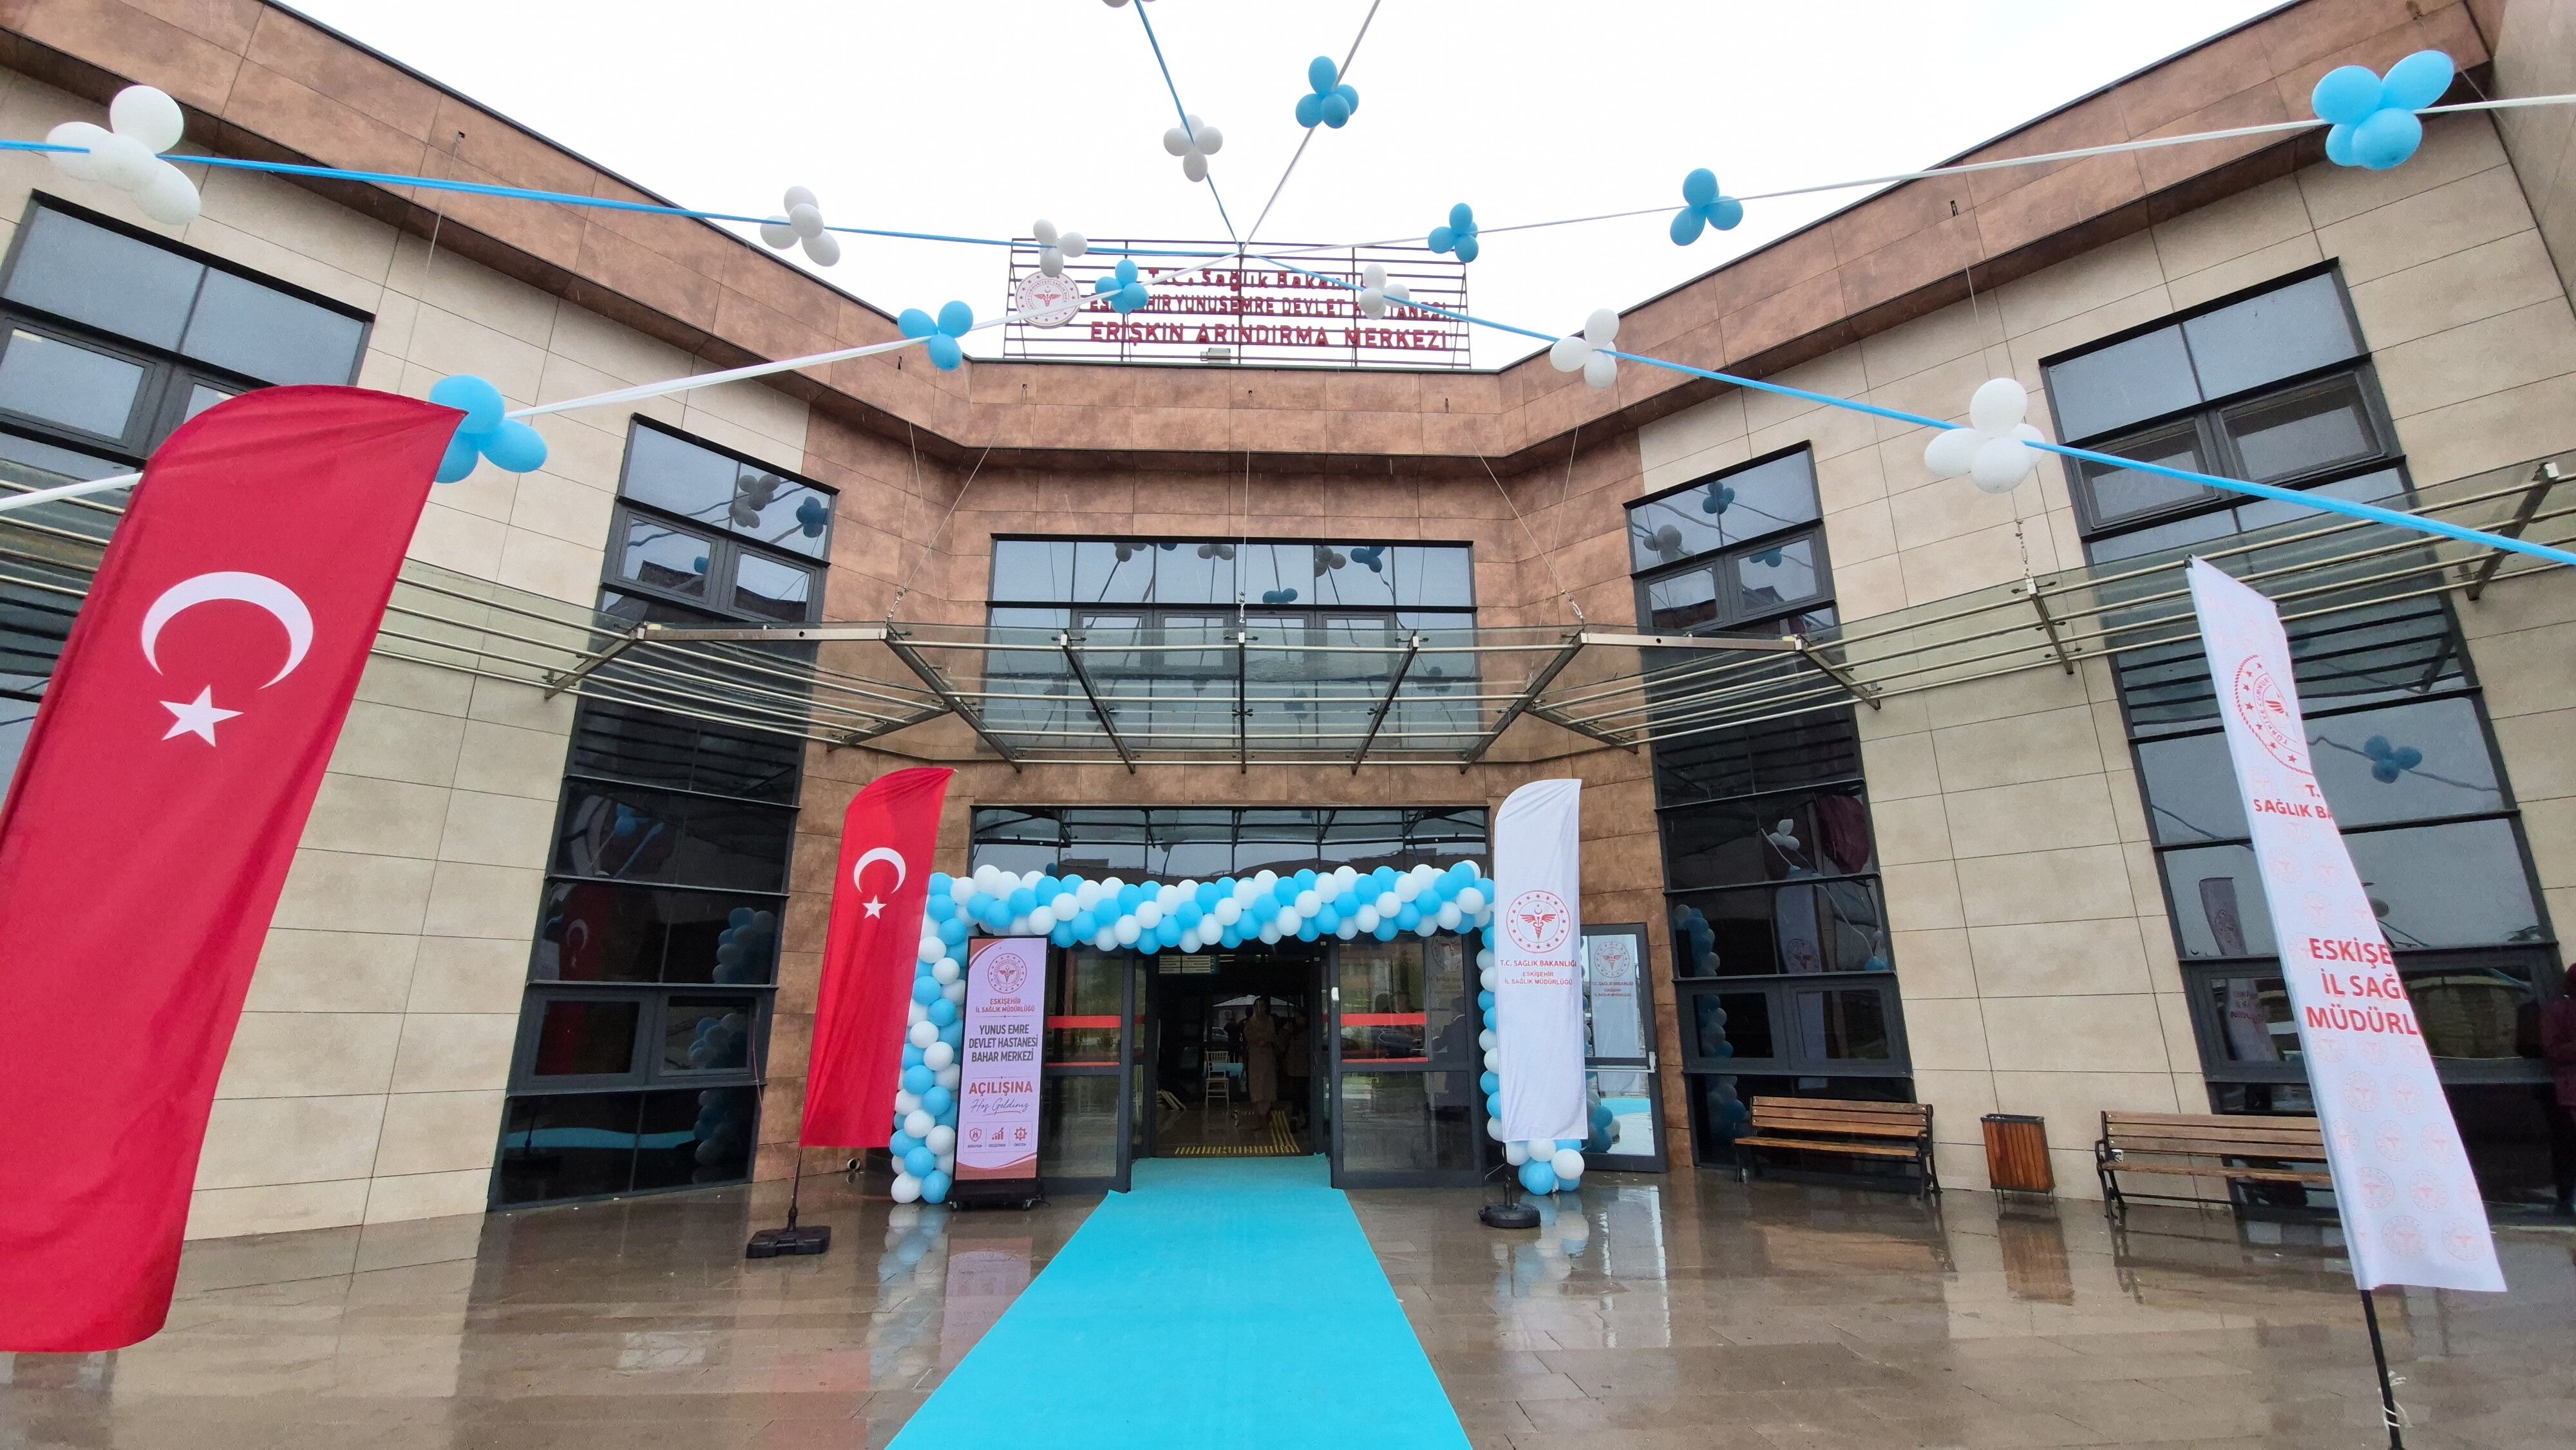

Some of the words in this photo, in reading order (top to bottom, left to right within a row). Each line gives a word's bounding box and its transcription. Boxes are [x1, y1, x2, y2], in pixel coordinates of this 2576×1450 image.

[1282, 297, 1345, 316] DEVLET
[1195, 323, 1329, 346] ARINDIRMA
[2253, 798, 2313, 818] SAĞLIK
[2321, 968, 2345, 995] İL
[990, 997, 1021, 1005] ESKİŞEHİR
[980, 1024, 1006, 1035] YUNUS
[1008, 1024, 1029, 1034] EMRE
[969, 1038, 996, 1048] DEVLET
[998, 1035, 1038, 1048] HASTANESİ
[972, 1051, 999, 1062] BAHAR
[1001, 1048, 1034, 1061] MERKEZİ
[969, 1081, 1033, 1097] AÇILIŞINA
